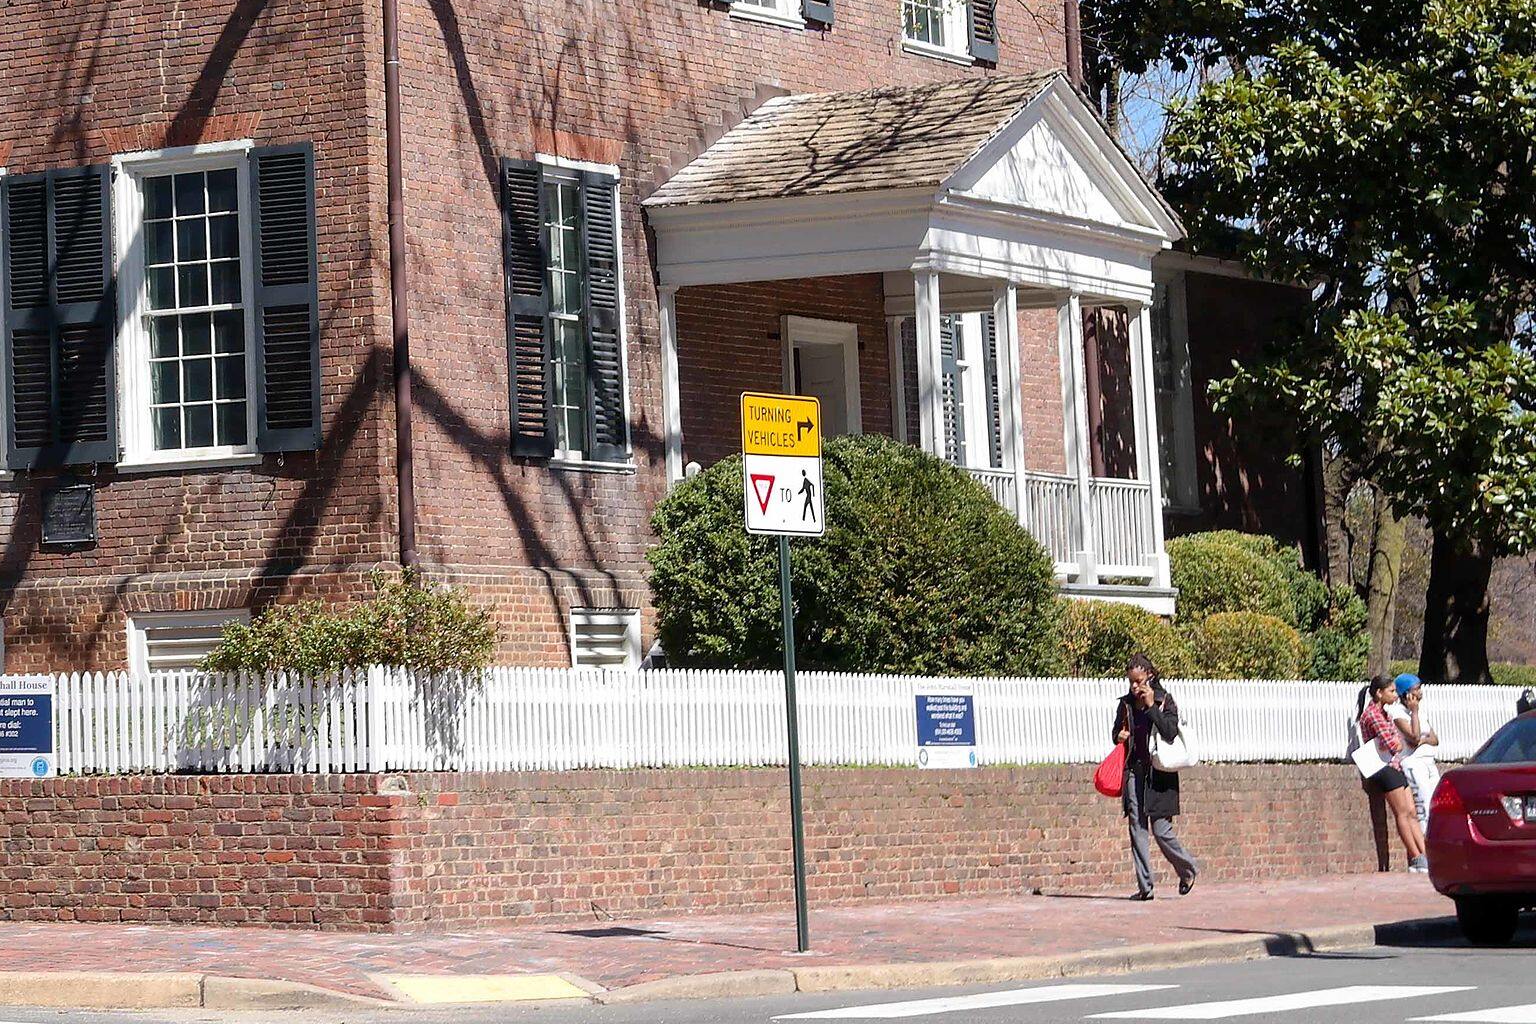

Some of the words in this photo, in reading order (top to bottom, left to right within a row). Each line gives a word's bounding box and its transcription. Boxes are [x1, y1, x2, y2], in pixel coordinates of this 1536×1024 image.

[748, 405, 792, 424] TURNING
[747, 430, 796, 448] VEHICLES
[779, 487, 792, 503] TO
[19, 680, 47, 690] House
[11, 699, 26, 707] man
[27, 699, 34, 707] to
[4, 708, 20, 718] slept
